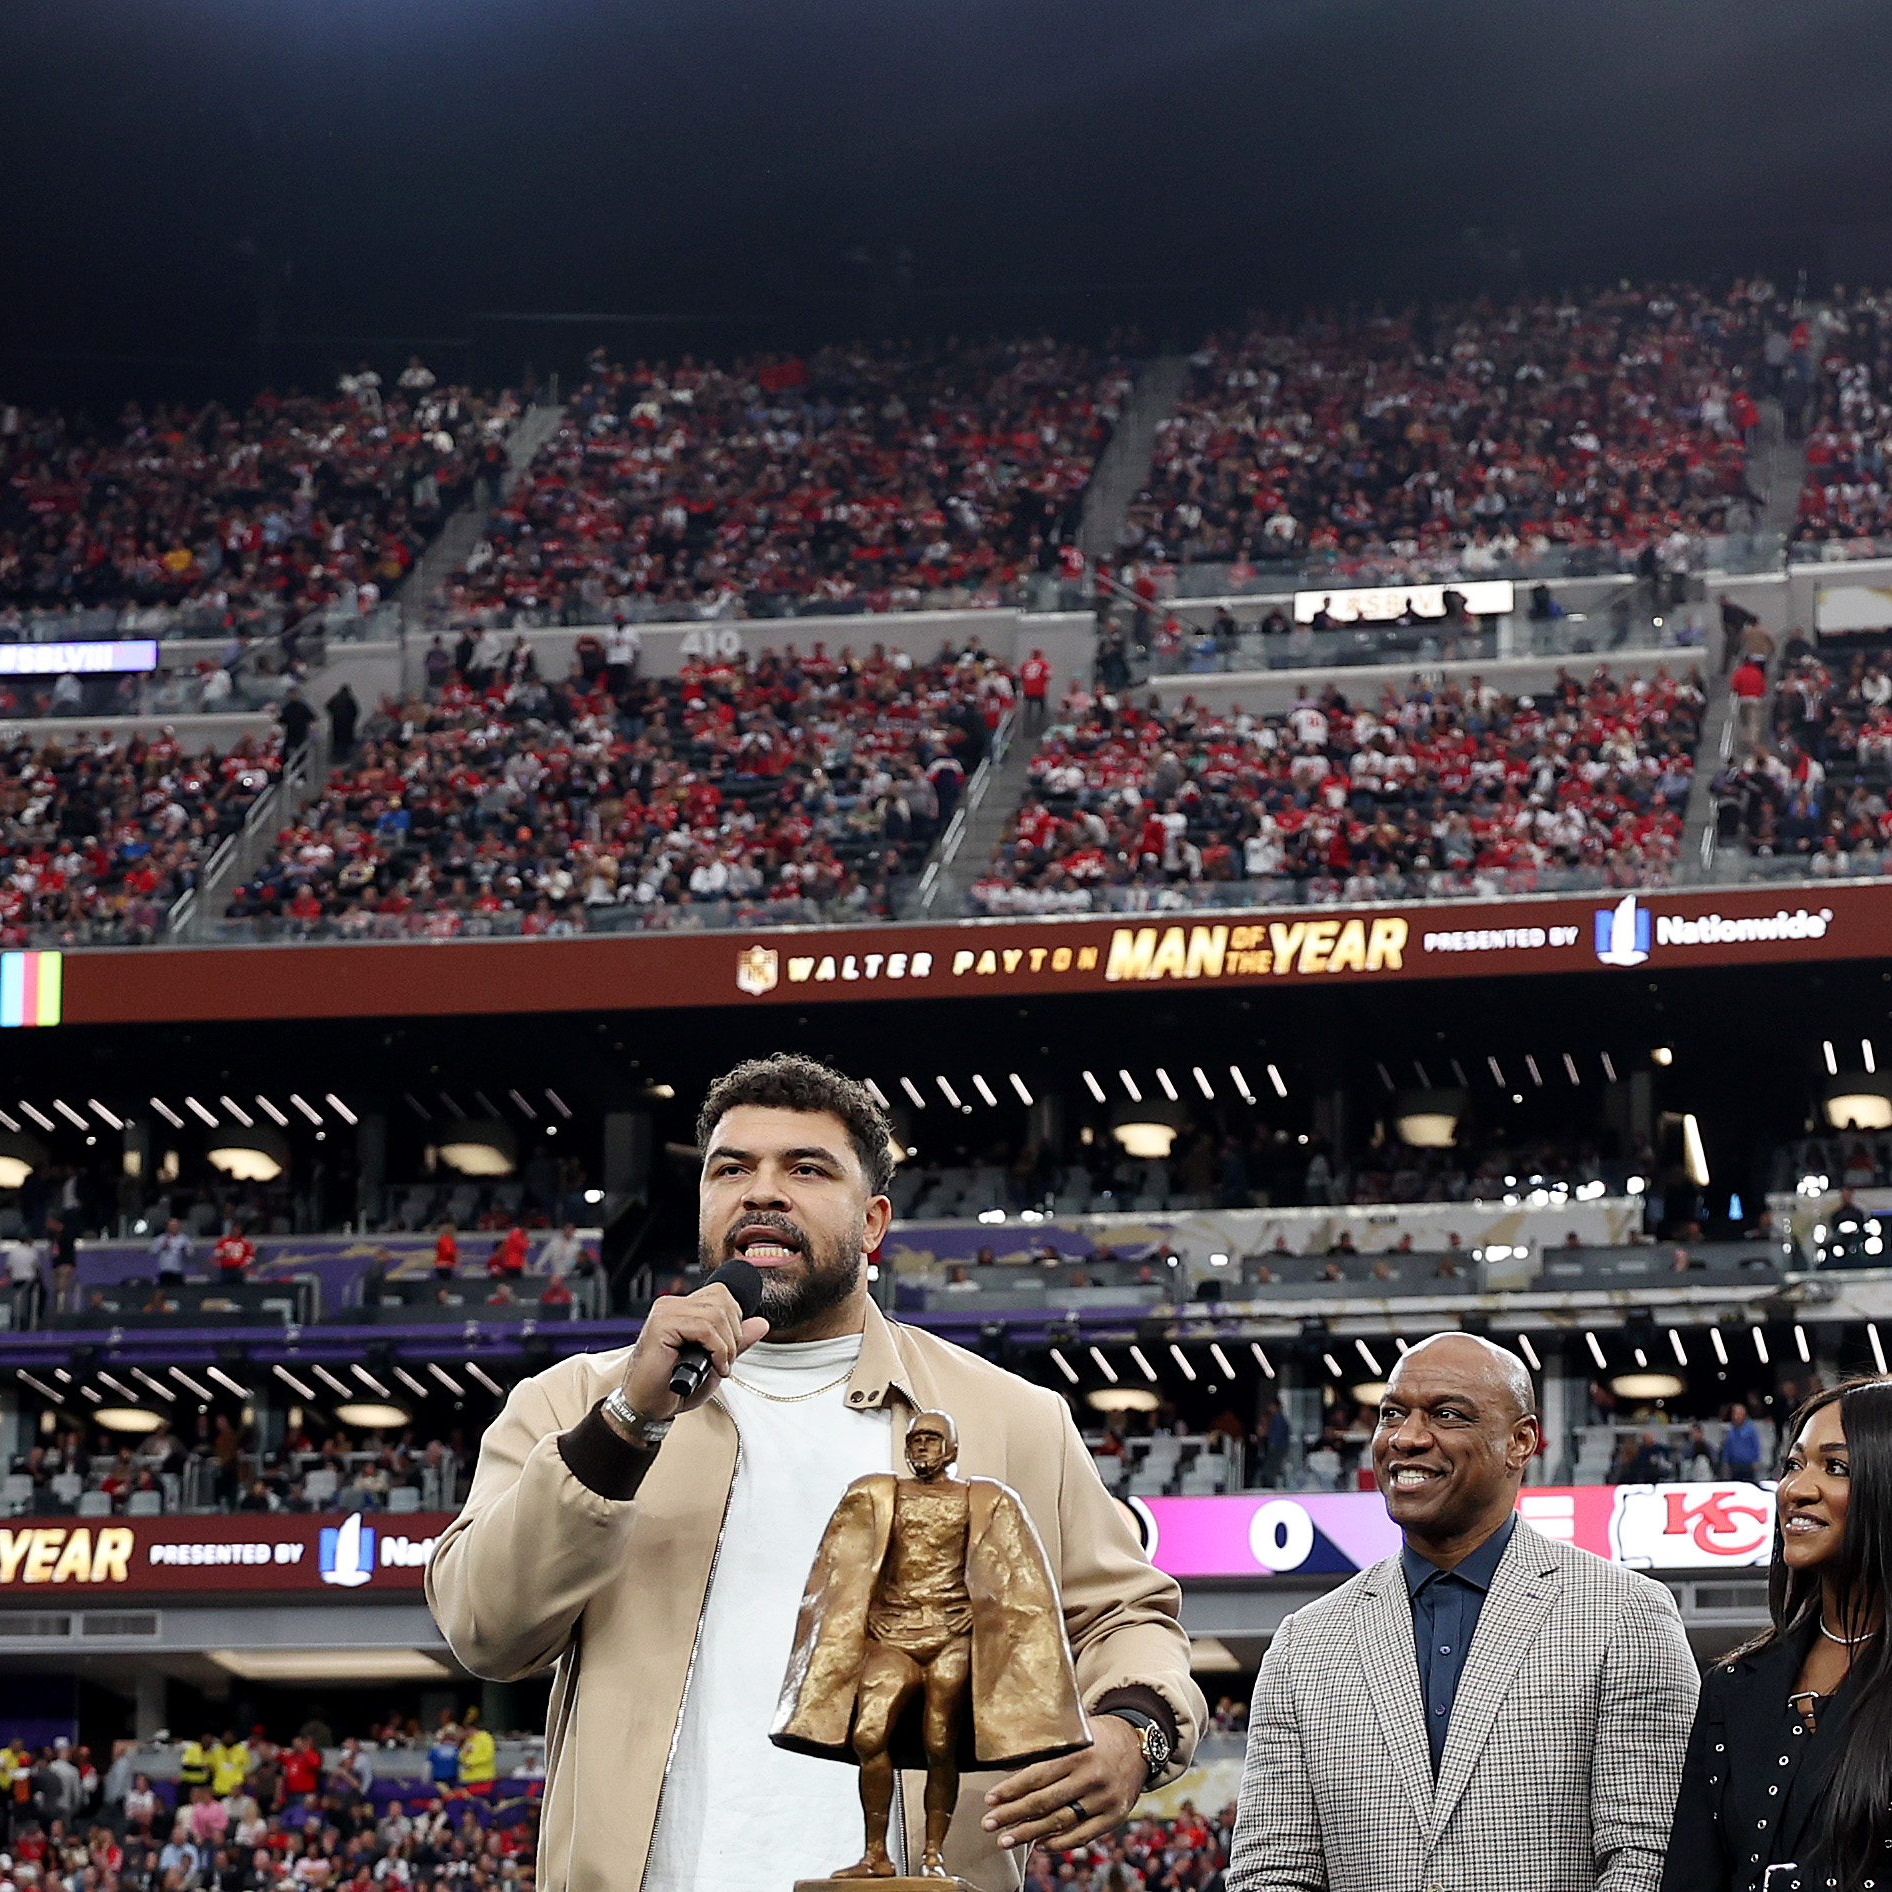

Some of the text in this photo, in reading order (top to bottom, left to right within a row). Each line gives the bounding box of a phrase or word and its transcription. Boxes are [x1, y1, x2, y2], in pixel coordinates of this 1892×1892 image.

[1231, 924, 1266, 949] OF
[1269, 917, 1408, 975] YEAR
[1424, 928, 1547, 951] PRESENTED
[1549, 925, 1580, 947] BY
[788, 951, 933, 982] WALTER
[952, 947, 1098, 975] PAYTON
[1105, 924, 1228, 981] MAN
[1227, 949, 1273, 975] THE
[1249, 1499, 1314, 1572] 0
[1662, 1491, 1768, 1556] KC
[149, 1544, 271, 1565] PRESENTED
[273, 1543, 305, 1564] BY
